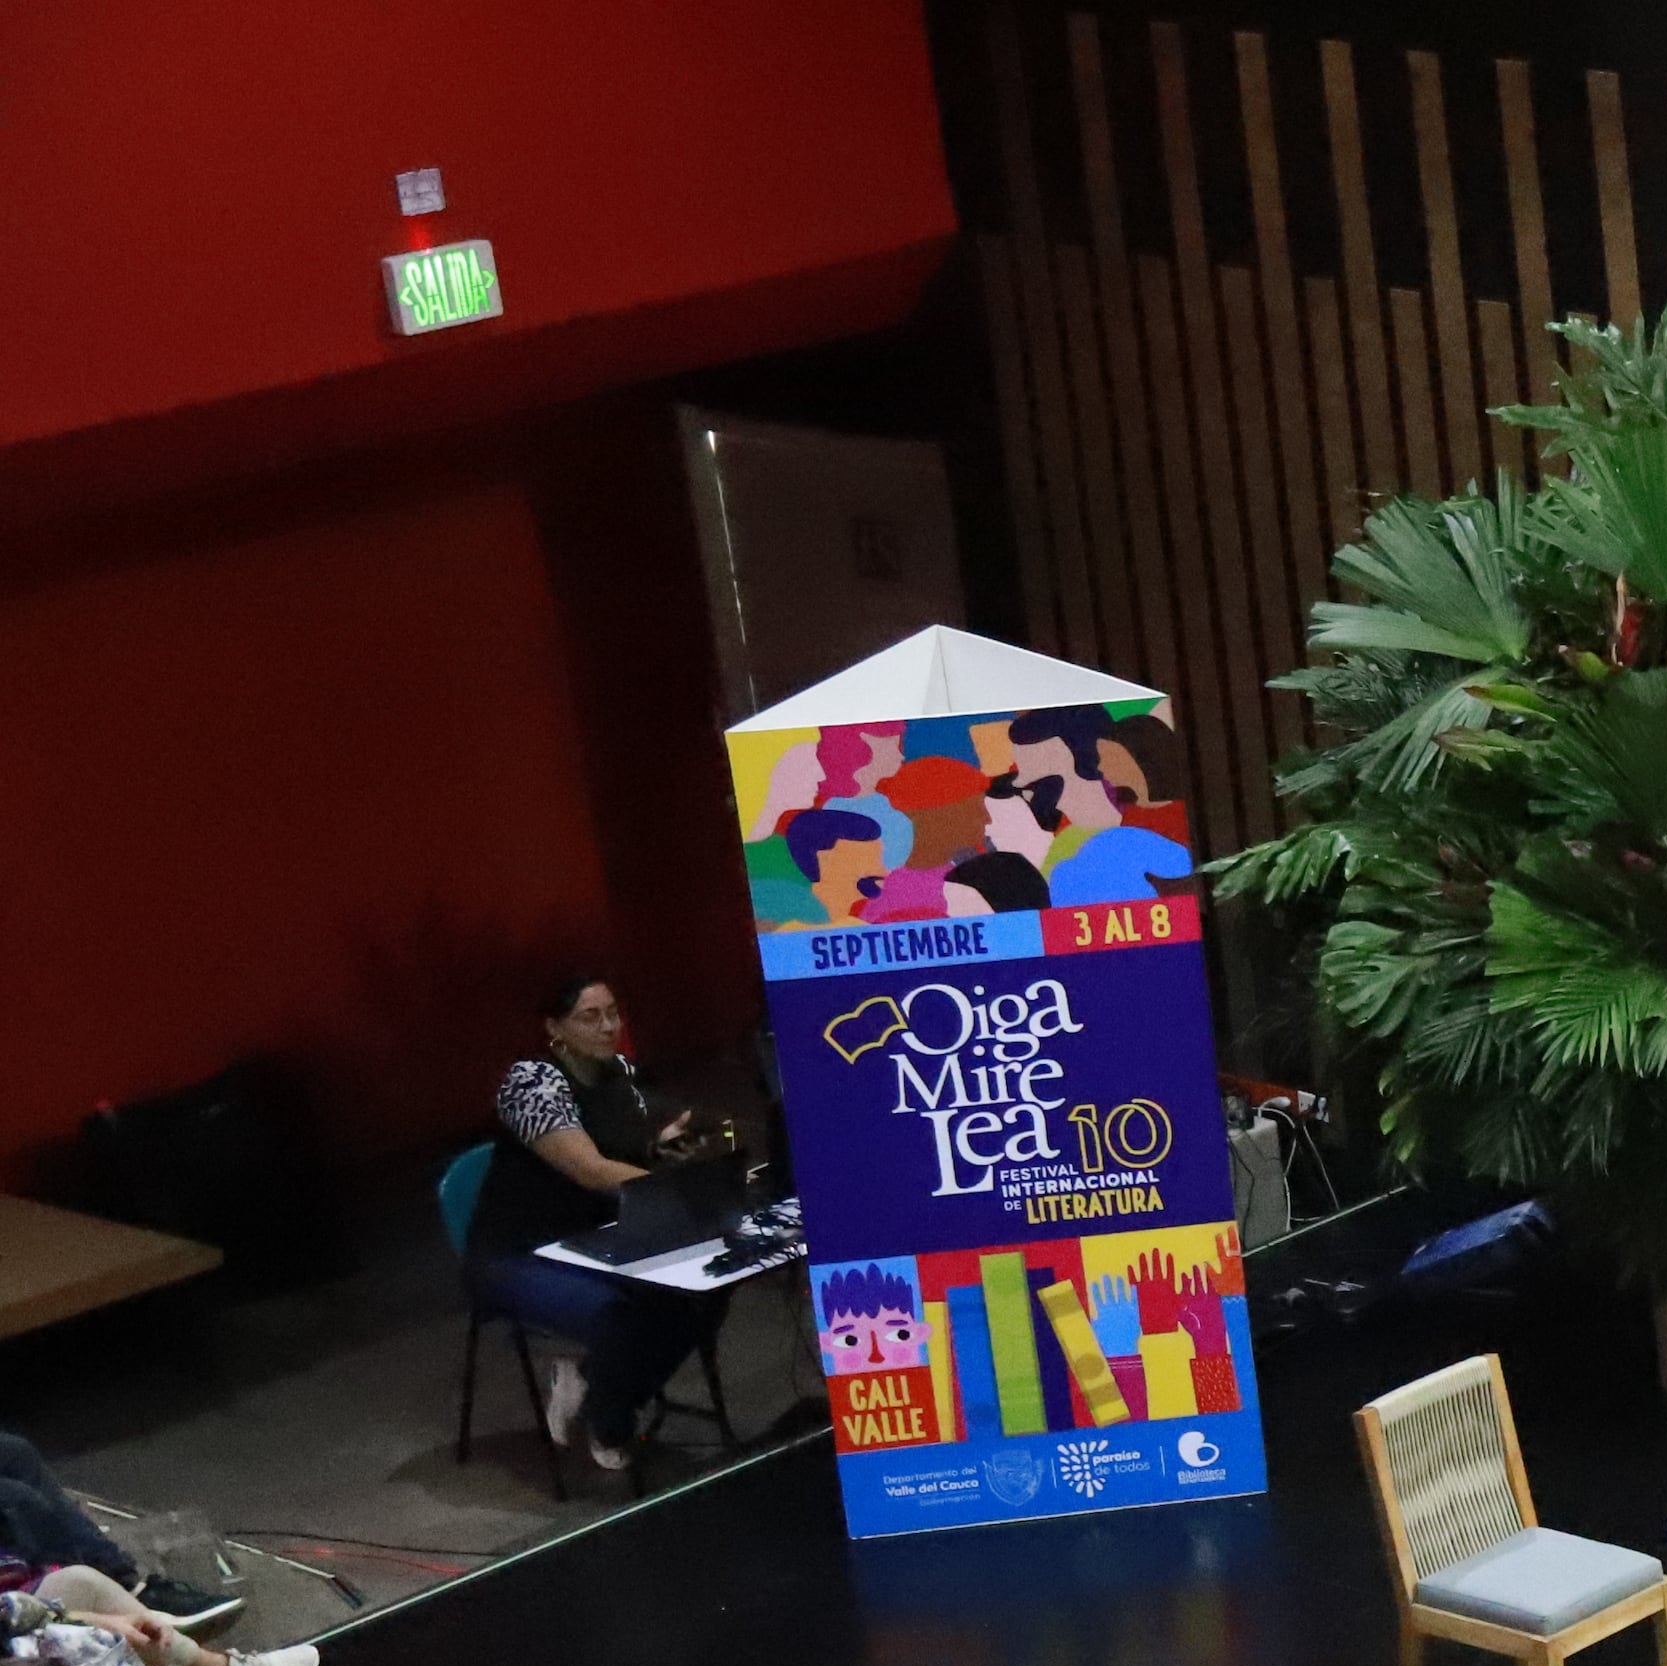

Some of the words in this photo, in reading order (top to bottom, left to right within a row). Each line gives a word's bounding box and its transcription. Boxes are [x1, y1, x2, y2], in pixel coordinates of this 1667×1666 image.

[404, 249, 491, 326] SALIDA
[811, 922, 988, 969] SEPTIEMBRE
[1073, 912, 1092, 946] 3
[1105, 907, 1141, 944] AL
[1151, 904, 1171, 938] 8
[901, 979, 1084, 1063] Oiga
[889, 1045, 1067, 1114] Mire
[920, 1103, 1061, 1197] Lea
[1068, 1099, 1173, 1173] 10
[1000, 1164, 1079, 1182] FESTIVAL
[1001, 1170, 1160, 1198] INTERNACIONAL
[1004, 1200, 1022, 1212] DE
[1026, 1185, 1165, 1225] LITERATURA
[849, 1375, 911, 1411] CALI
[842, 1407, 927, 1446] VALLE
[885, 1485, 916, 1497] Valle
[918, 1482, 938, 1494] del
[1094, 1466, 1111, 1477] de
[1115, 1462, 1150, 1474] todos
